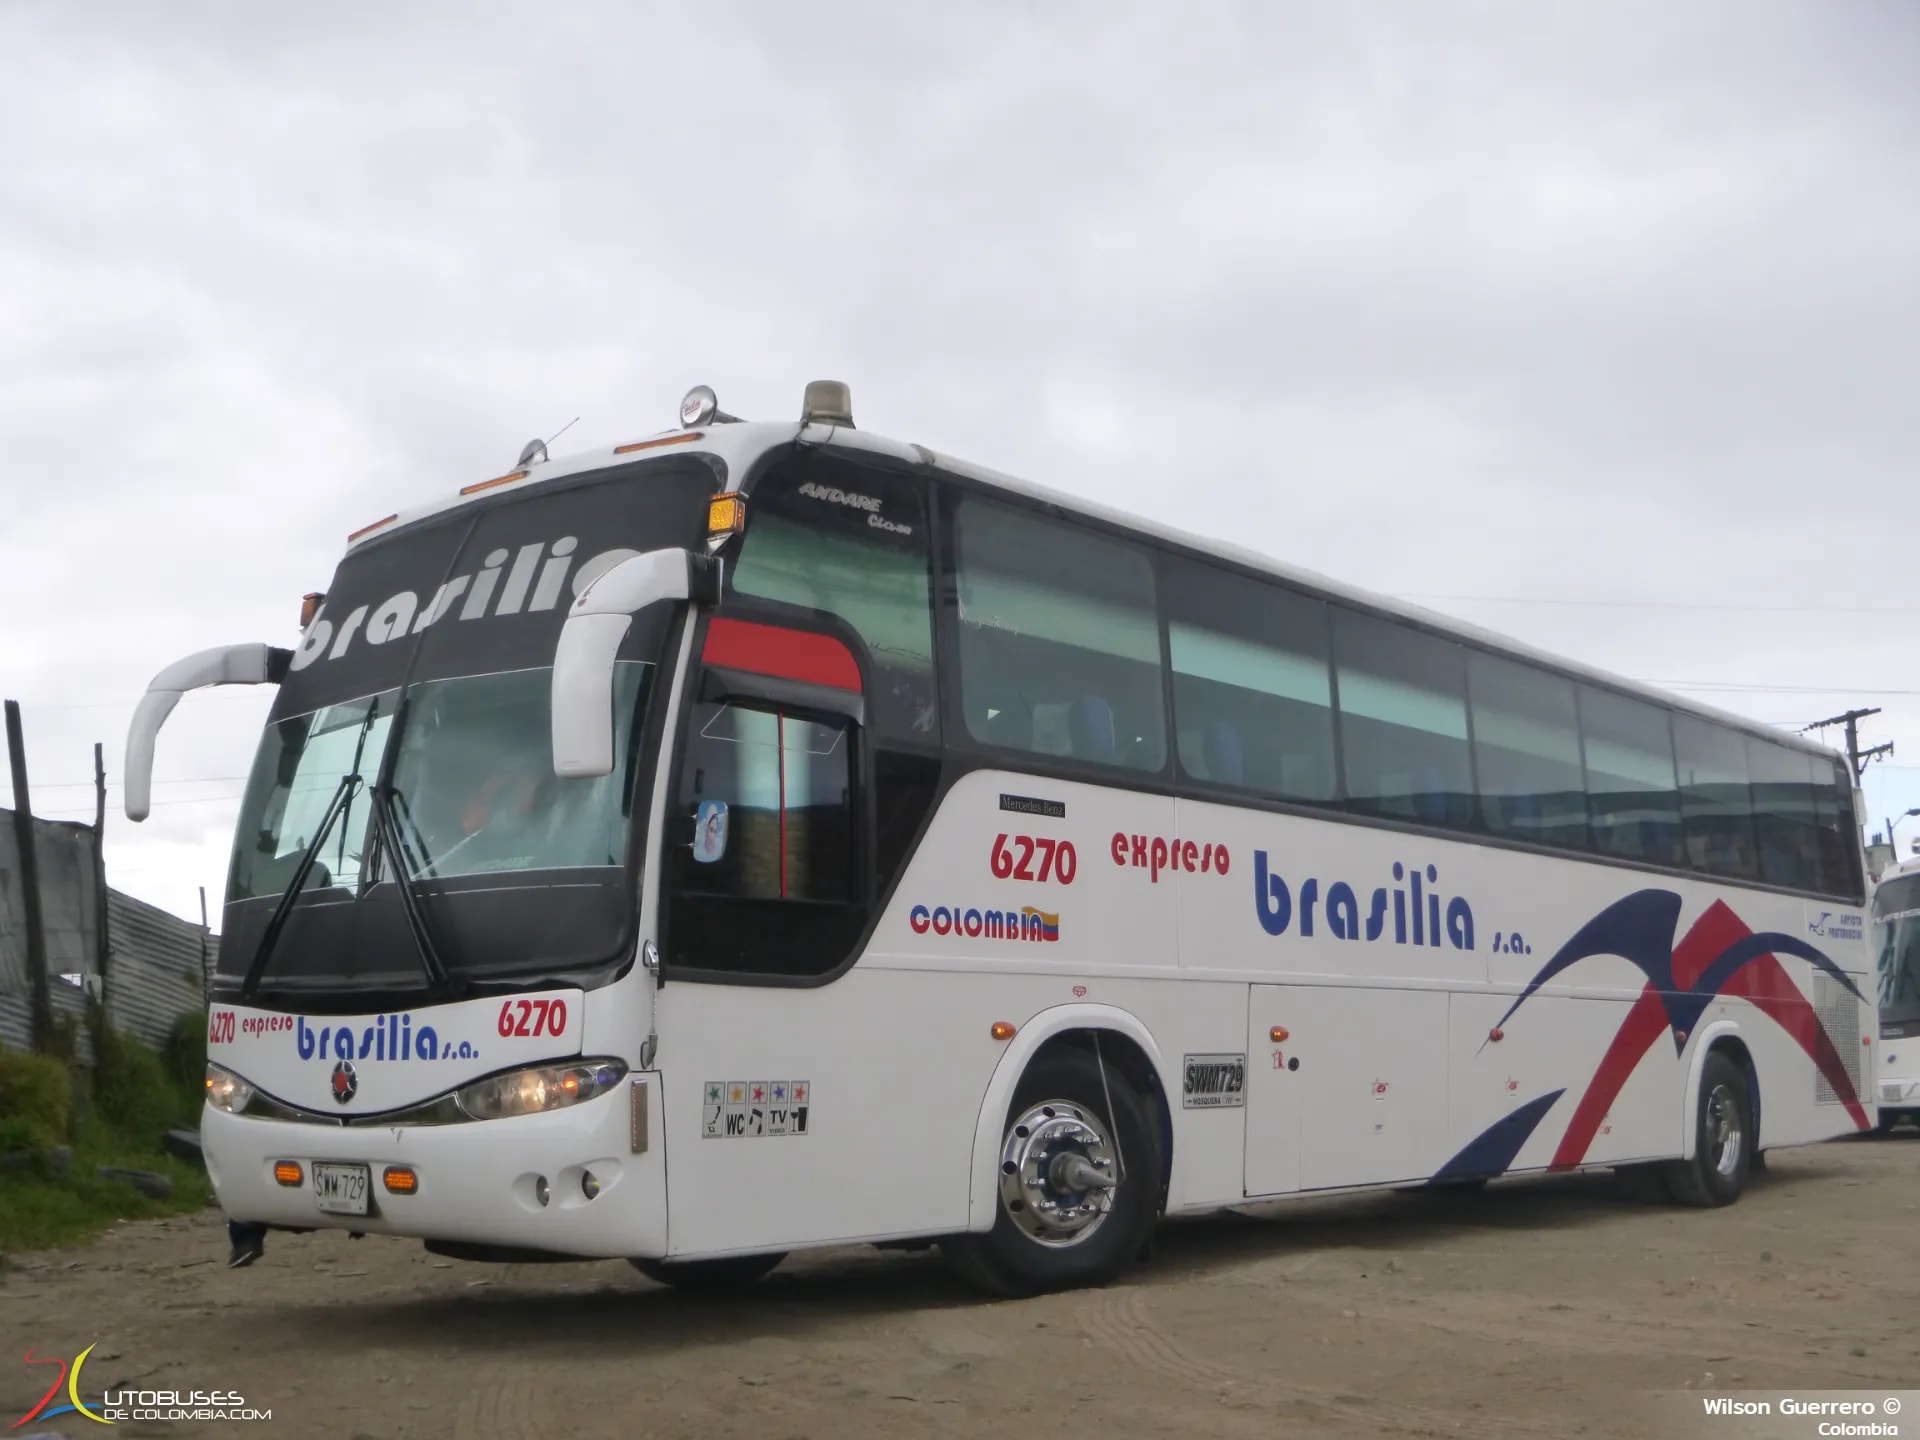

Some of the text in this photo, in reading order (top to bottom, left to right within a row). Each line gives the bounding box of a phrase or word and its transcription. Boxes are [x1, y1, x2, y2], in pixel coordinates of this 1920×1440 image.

[798, 482, 883, 513] ANDARE
[1002, 796, 1064, 815] Mercedes Benz
[990, 833, 1077, 885] 6270
[1110, 831, 1532, 954] expreso brasilia s.a.
[910, 904, 1043, 942] COLOMBIA
[209, 1012, 235, 1044] 6270
[498, 999, 567, 1037] 6270
[242, 1014, 479, 1061] expreso brasilia s.a.
[1184, 1063, 1243, 1093] SWM729
[727, 1113, 745, 1135] WC
[770, 1110, 787, 1124] TV
